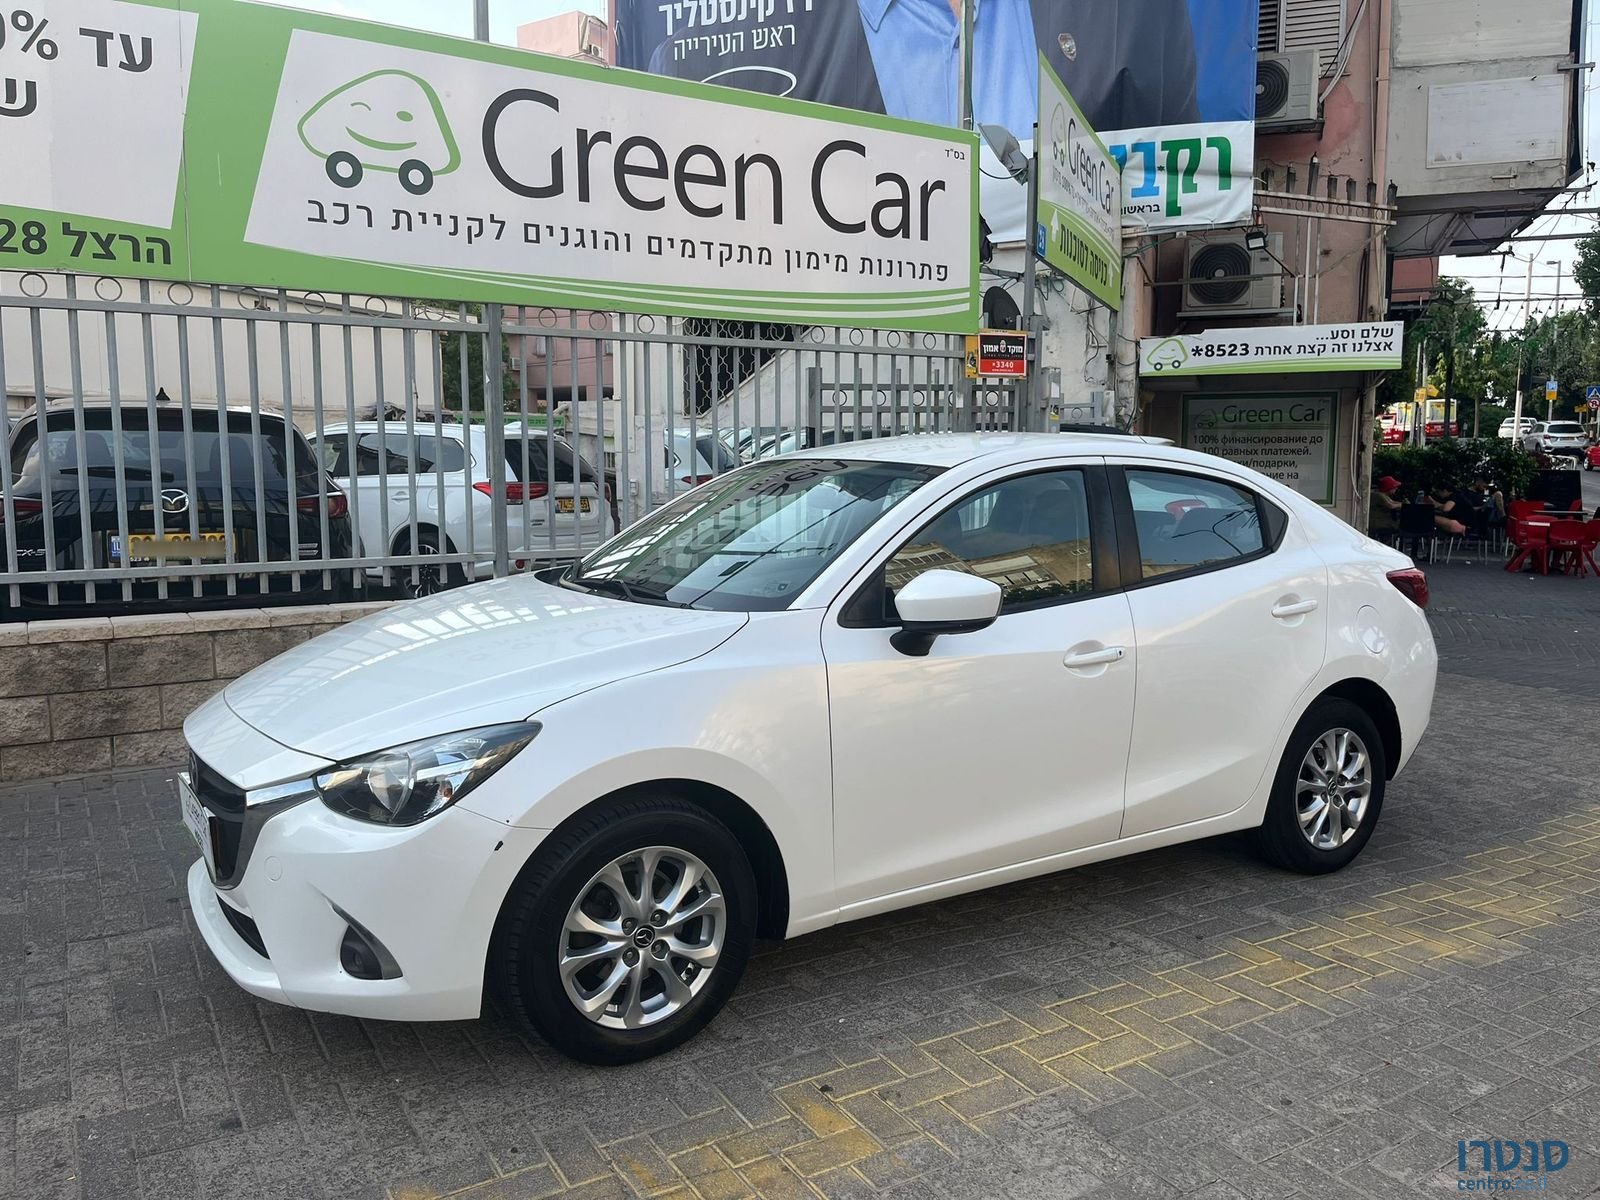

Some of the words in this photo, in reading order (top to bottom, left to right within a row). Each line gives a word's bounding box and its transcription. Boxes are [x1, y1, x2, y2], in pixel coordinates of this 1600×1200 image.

[674, 31, 744, 61] העירייה
[751, 24, 796, 50] ראש
[79, 28, 153, 73] עד
[482, 88, 783, 226] Green
[811, 140, 946, 241] Car
[945, 148, 965, 160] בס"ד
[1067, 118, 1098, 201] Green
[1099, 160, 1115, 215] Car
[1160, 136, 1232, 217] רק
[307, 200, 373, 227] רכב
[391, 208, 506, 244] לקניית
[62, 222, 172, 265] הרצל
[523, 222, 631, 253] והוגנים
[1059, 223, 1089, 271] לסוכנות
[647, 235, 772, 267] מתקדמים
[784, 249, 848, 273] מימון
[859, 256, 949, 282] פתרונות
[1089, 250, 1108, 286] כניסה
[1360, 326, 1394, 339] שלם
[982, 344, 999, 354] אמון
[1007, 345, 1024, 354] מוקד
[1253, 343, 1293, 356] אחרת
[1296, 342, 1327, 357] קצת
[1331, 341, 1347, 353] זה
[1352, 340, 1394, 353] אצלנו
[1222, 404, 1283, 423] Green
[1288, 403, 1326, 422] Car
[1193, 434, 1219, 445] 100%
[1221, 434, 1308, 445] финансирование
[1309, 436, 1323, 445] до
[1221, 447, 1259, 457] равных
[1261, 446, 1312, 456] платежей.
[1287, 472, 1299, 480] на
